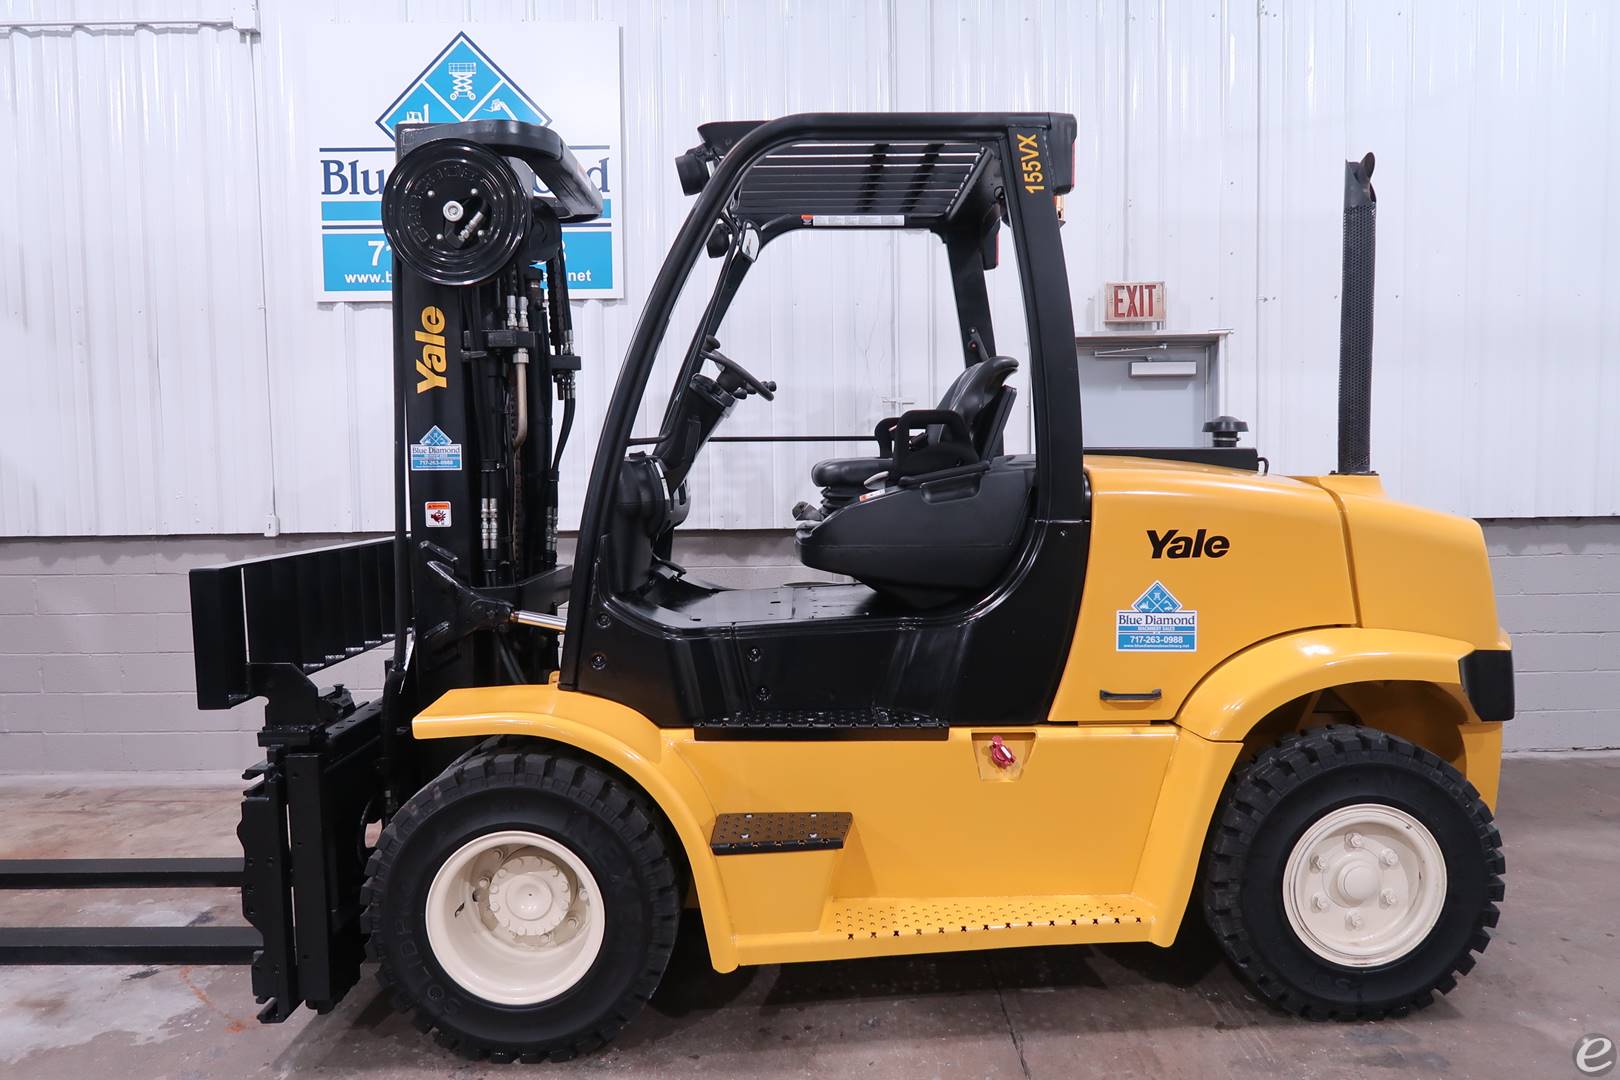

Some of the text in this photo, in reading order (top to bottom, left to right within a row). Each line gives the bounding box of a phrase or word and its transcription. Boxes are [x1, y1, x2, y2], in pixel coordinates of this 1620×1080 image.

[320, 159, 386, 196] Blu
[1016, 133, 1045, 194] 155VX
[1113, 284, 1157, 318] EXIT
[414, 305, 448, 394] Yale
[1146, 529, 1230, 559] Yale
[1118, 615, 1195, 625] Blue Diamond
